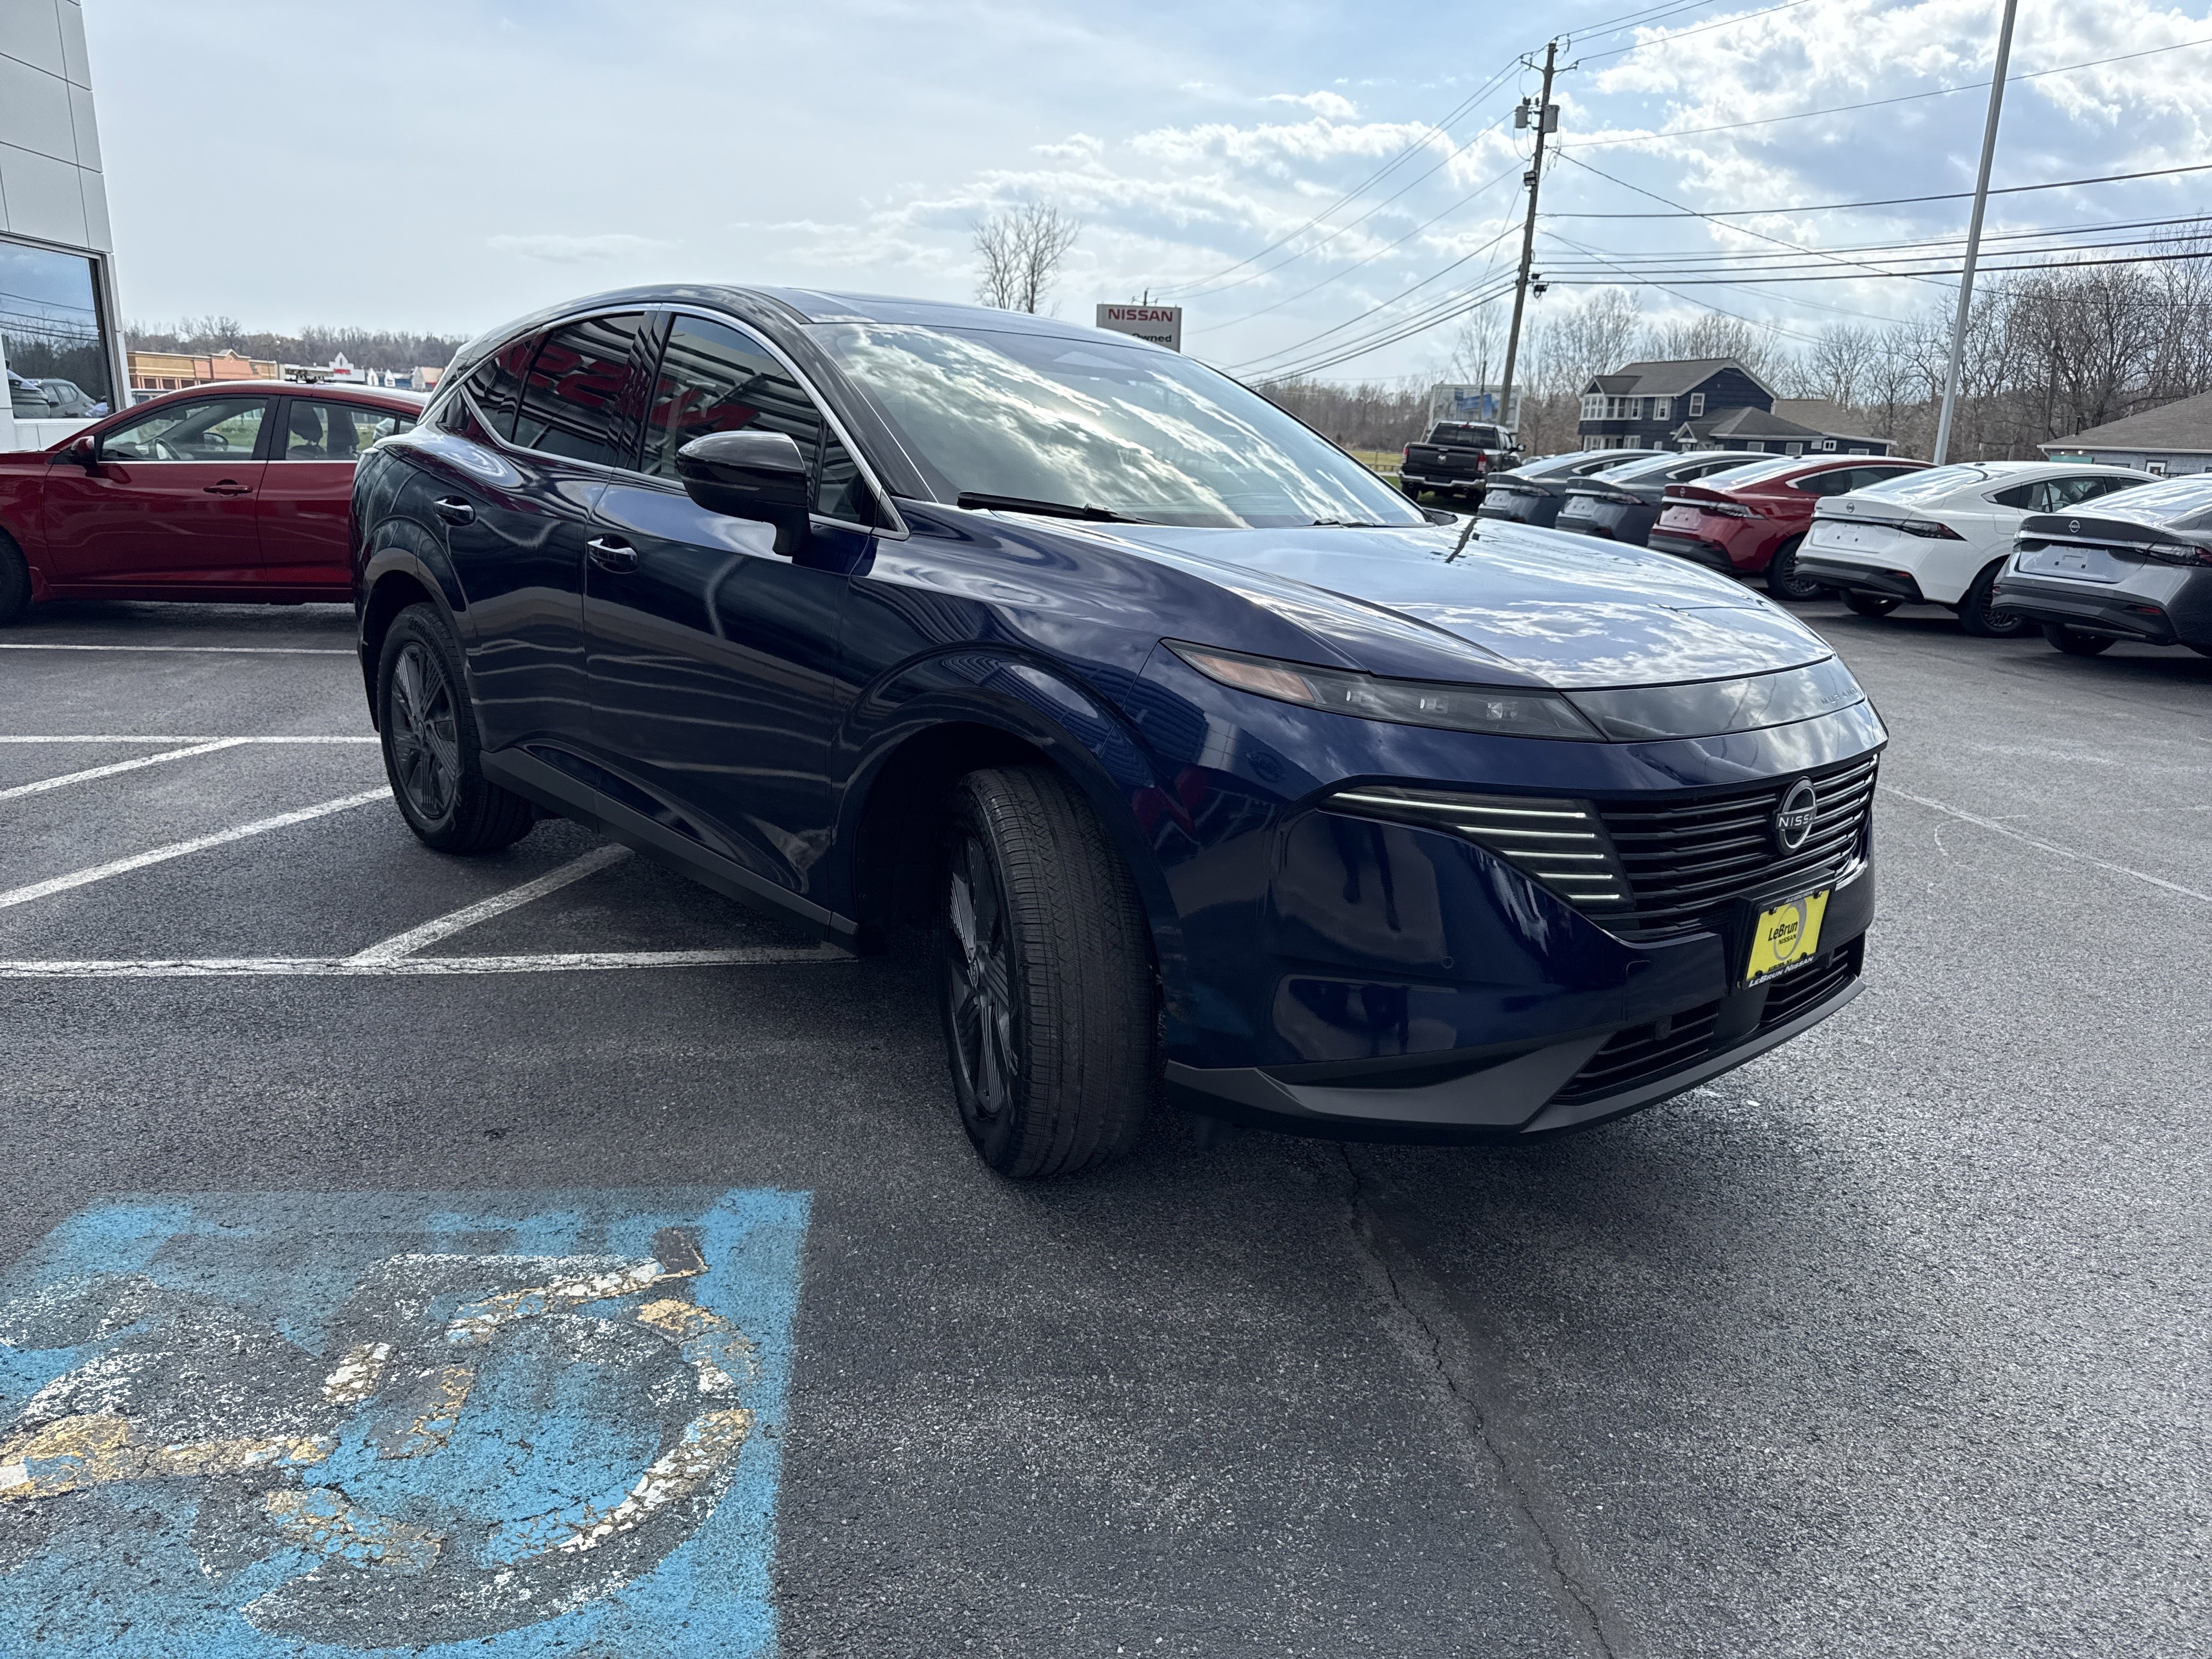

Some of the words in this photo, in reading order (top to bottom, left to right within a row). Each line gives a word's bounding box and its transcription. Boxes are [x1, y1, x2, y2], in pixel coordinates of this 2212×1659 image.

[1108, 308, 1173, 322] NISSAN
[1778, 813, 1813, 827] NISS
[1768, 921, 1798, 941] LeBrun
[1778, 934, 1797, 945] NISSAN
